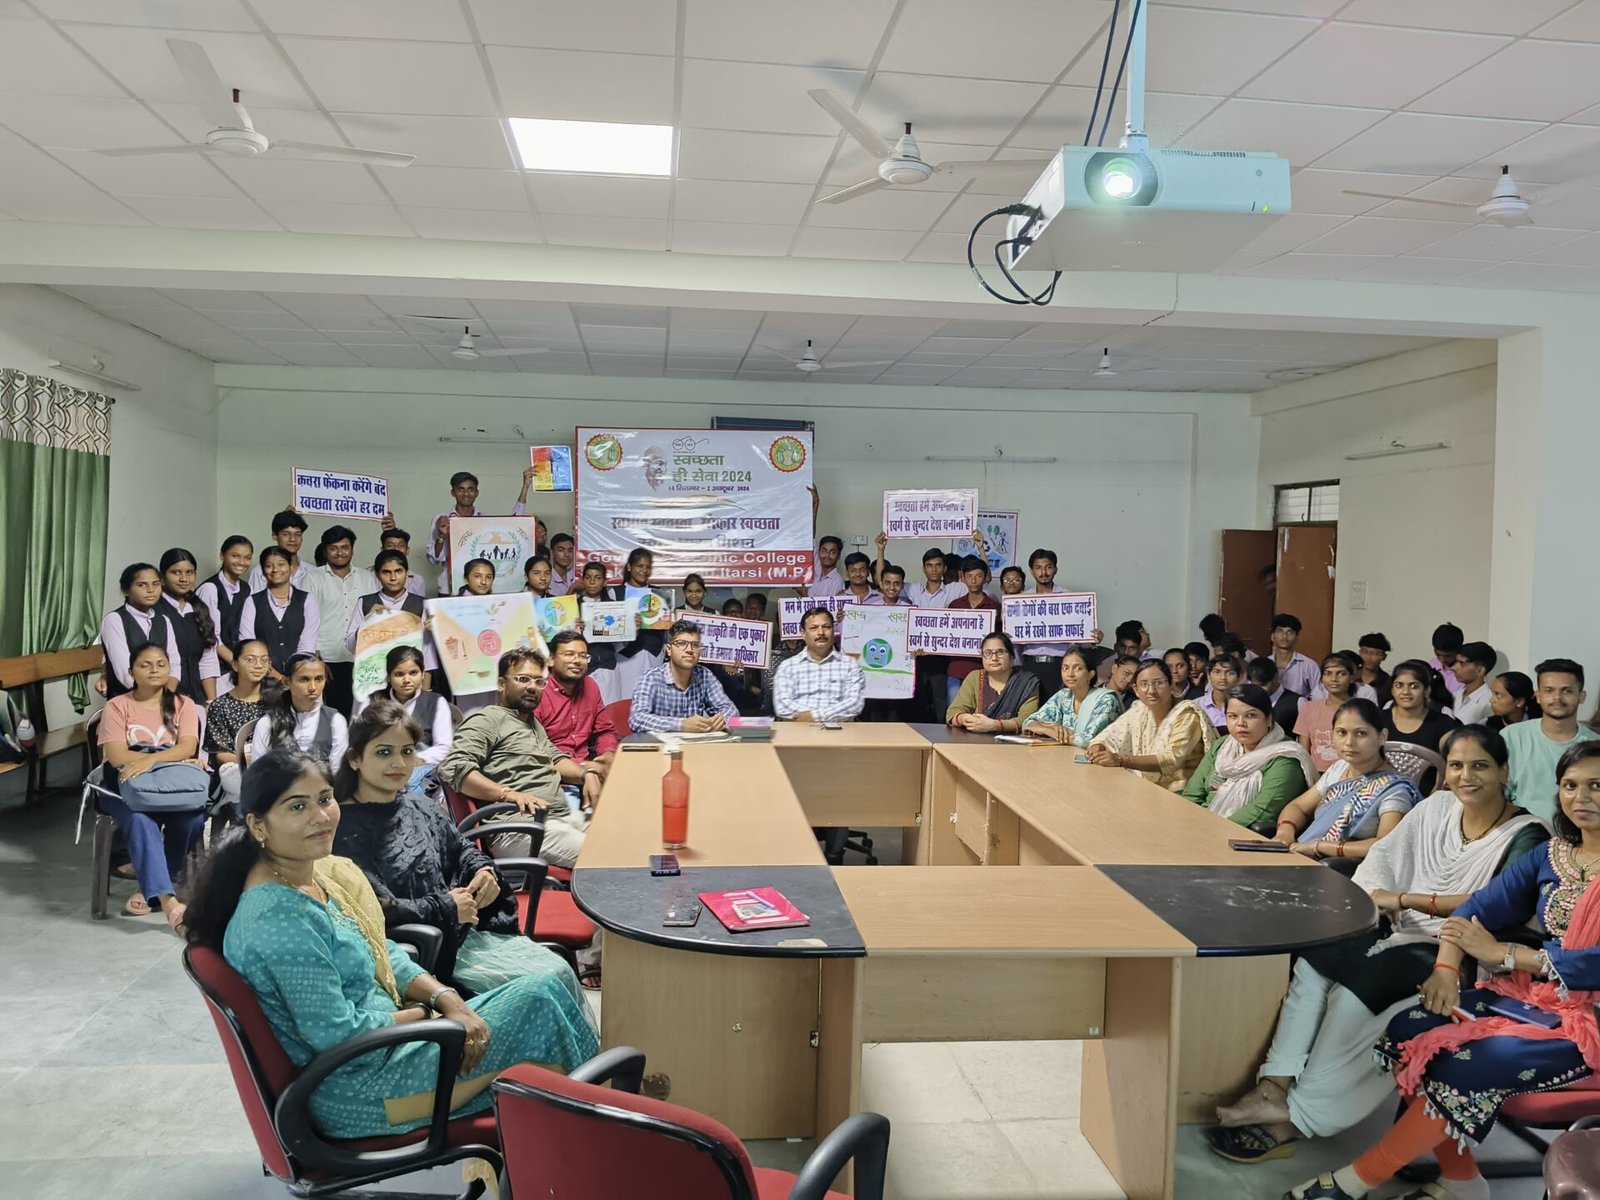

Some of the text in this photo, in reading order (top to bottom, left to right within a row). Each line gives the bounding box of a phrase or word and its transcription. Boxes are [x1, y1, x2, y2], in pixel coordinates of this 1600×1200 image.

[673, 455, 724, 466] स्वच्छता
[672, 467, 752, 482] ही सेवा 2024
[297, 473, 386, 496] कचरा फेंकना करेंगे बंद
[300, 496, 385, 516] स्वच्छता रखेंगे हर दम
[740, 517, 780, 530] स्वच्छता
[889, 516, 903, 532] स्वर्ग
[904, 516, 910, 531] से
[912, 519, 929, 535] सुन्दर
[931, 516, 941, 531] देश
[943, 519, 964, 531] बनाना
[744, 552, 806, 566] College
[785, 601, 795, 613] मन
[828, 596, 835, 611] ही
[1037, 600, 1047, 616] की
[1048, 602, 1059, 615] बस
[1061, 602, 1072, 615] एक
[1074, 597, 1091, 616] दवाई
[782, 622, 798, 635] स्वच्छ
[915, 613, 984, 630] स्वच्छता हमें अपनाना है
[1014, 625, 1023, 638] घर
[1033, 620, 1046, 638] रखो
[1048, 624, 1064, 637] साफ
[1065, 619, 1084, 638] सफाई
[738, 627, 749, 640] एक
[750, 629, 765, 646] पुकार
[910, 632, 982, 651] स्वर्ग से सुन्दर देश बनाना
[734, 646, 759, 663] अधिकार
